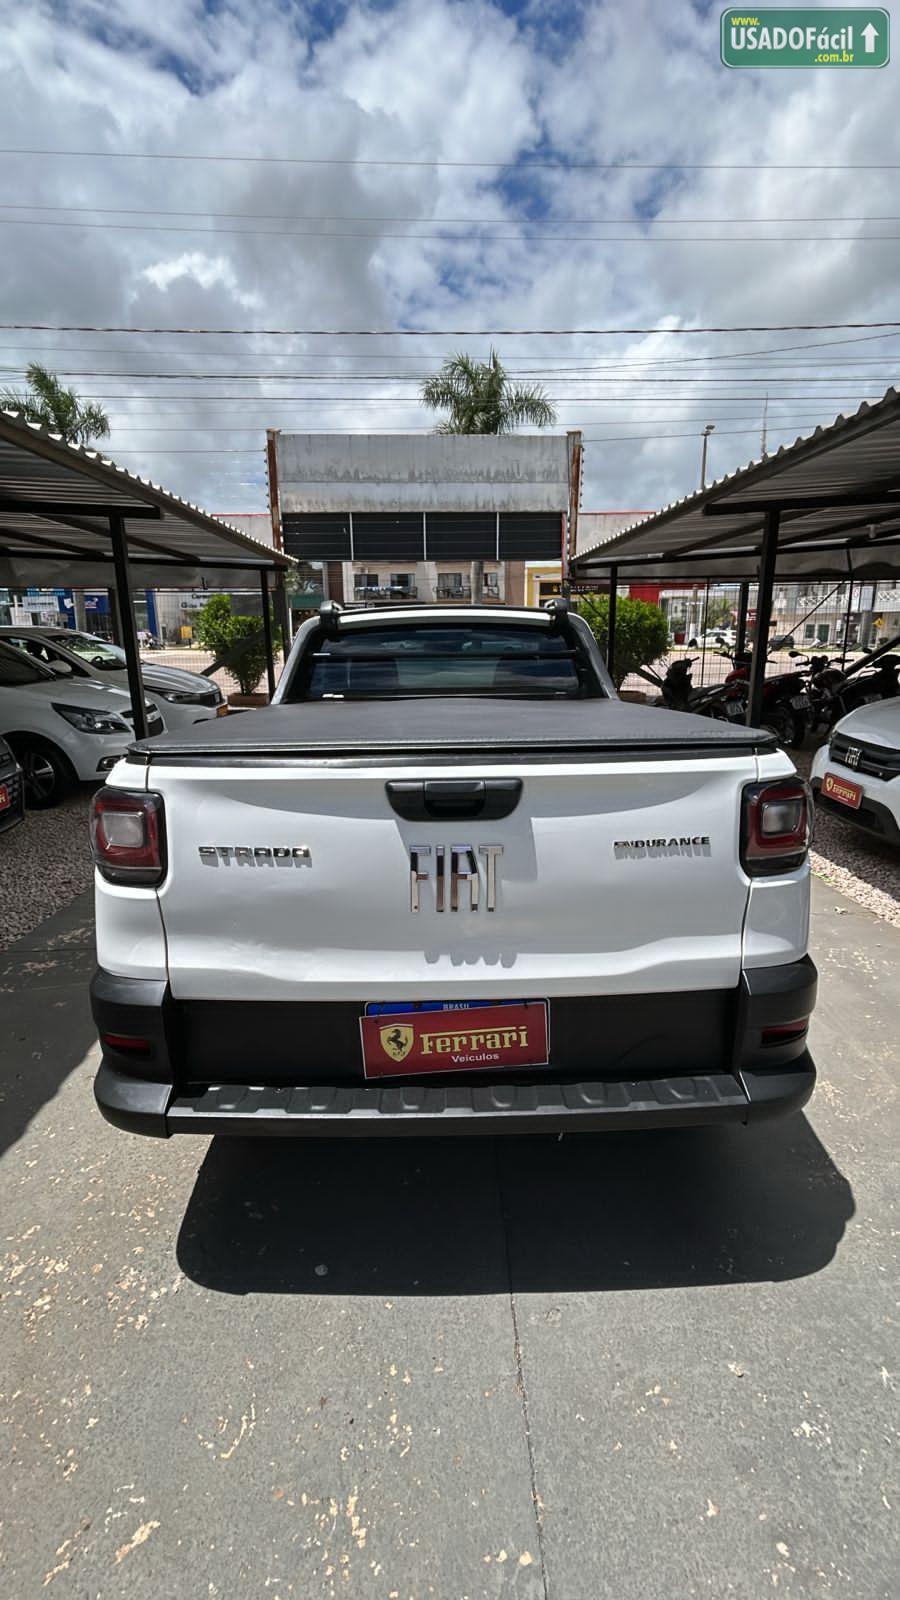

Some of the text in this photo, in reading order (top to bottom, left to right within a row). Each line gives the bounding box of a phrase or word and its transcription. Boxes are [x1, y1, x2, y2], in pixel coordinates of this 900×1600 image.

[198, 846, 312, 859] STRADA
[613, 836, 711, 849] ENDURANCE
[409, 844, 504, 913] FIAT
[420, 1026, 529, 1055] Ferrari
